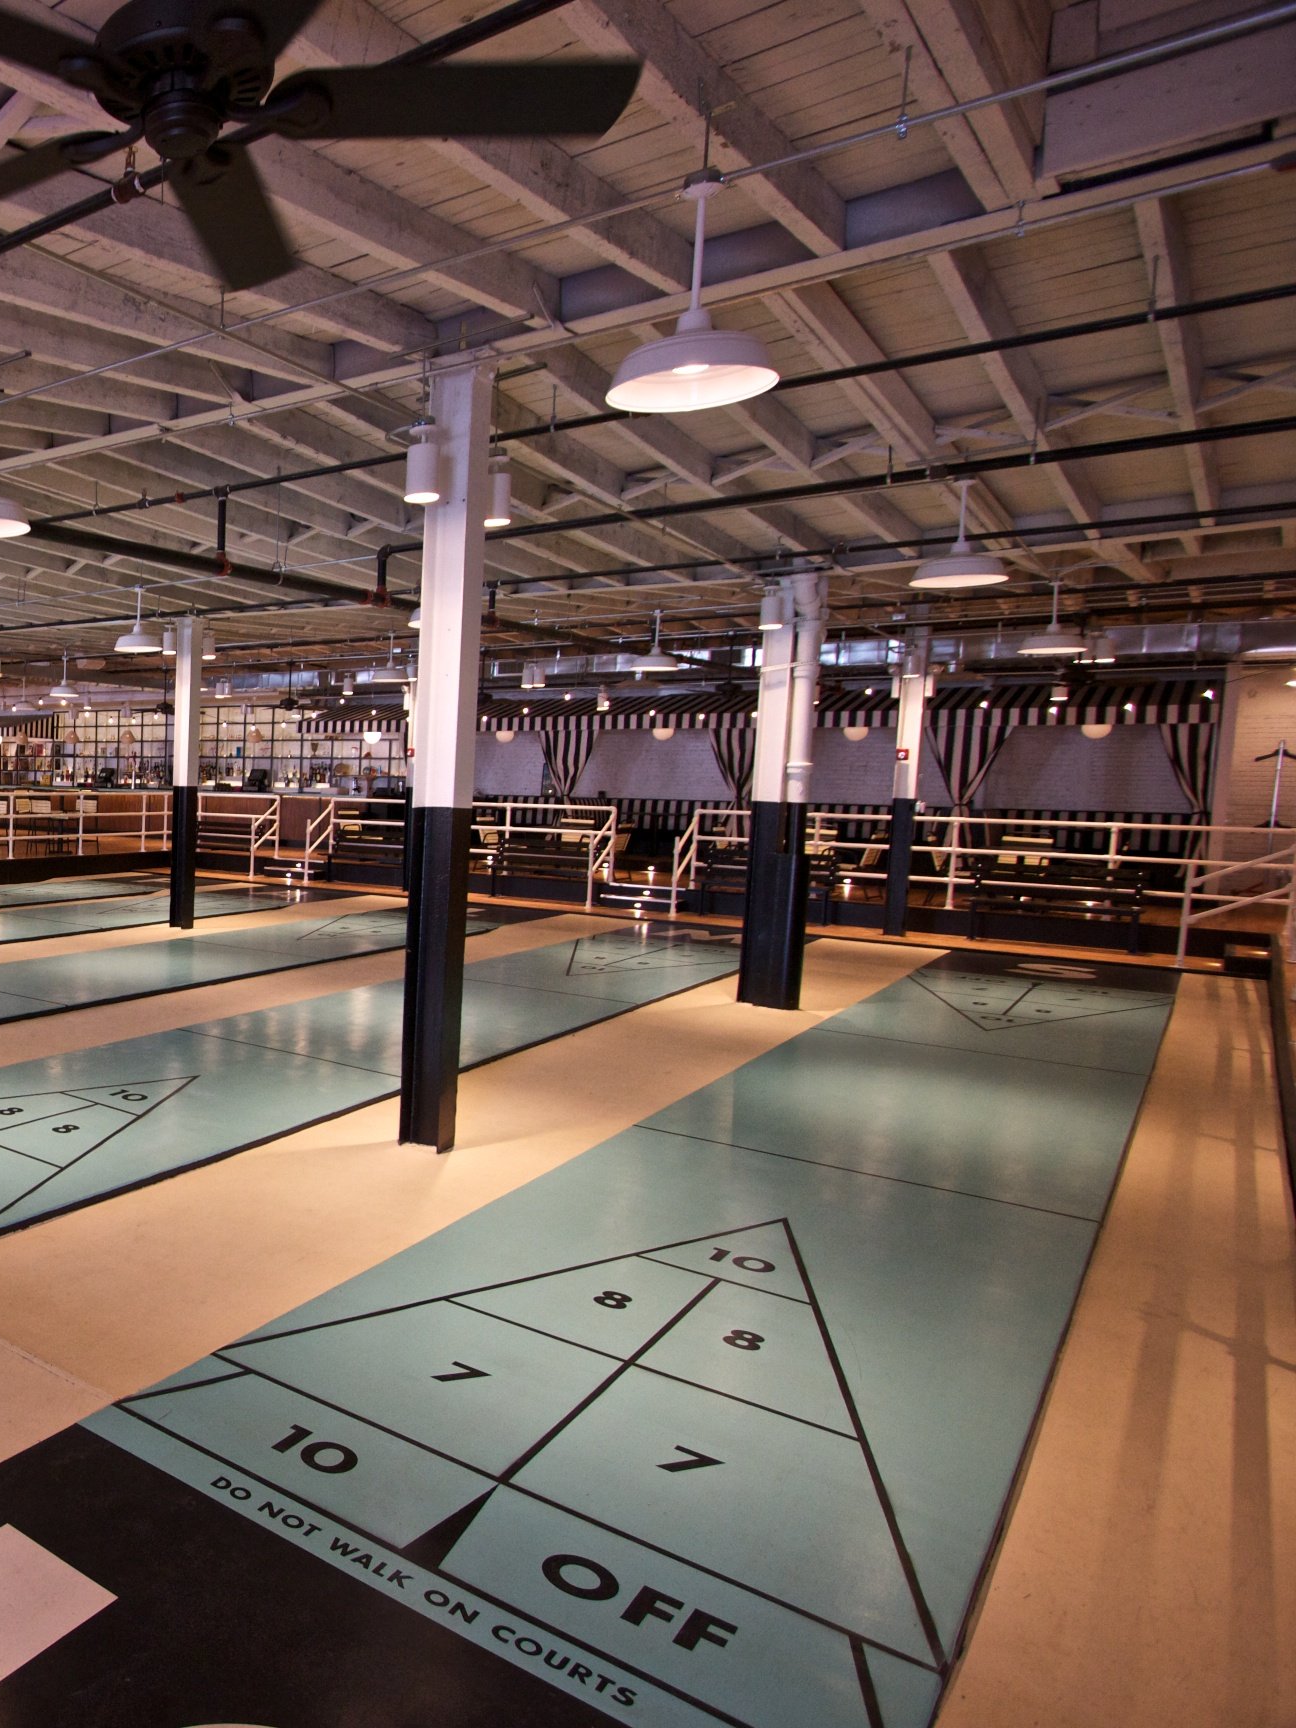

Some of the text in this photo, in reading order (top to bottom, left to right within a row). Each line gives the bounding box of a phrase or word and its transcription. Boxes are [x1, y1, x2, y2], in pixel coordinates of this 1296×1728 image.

[109, 1089, 149, 1102] 10
[52, 1124, 80, 1134] 8
[708, 1247, 776, 1273] 10
[593, 1290, 633, 1310] 8
[722, 1329, 765, 1351] 8
[430, 1360, 492, 1382] 7
[270, 1423, 359, 1474] 10
[655, 1445, 726, 1473] 7
[210, 1475, 638, 1708] DO NOT WALK ON COURTS
[541, 1553, 739, 1652] OFF
